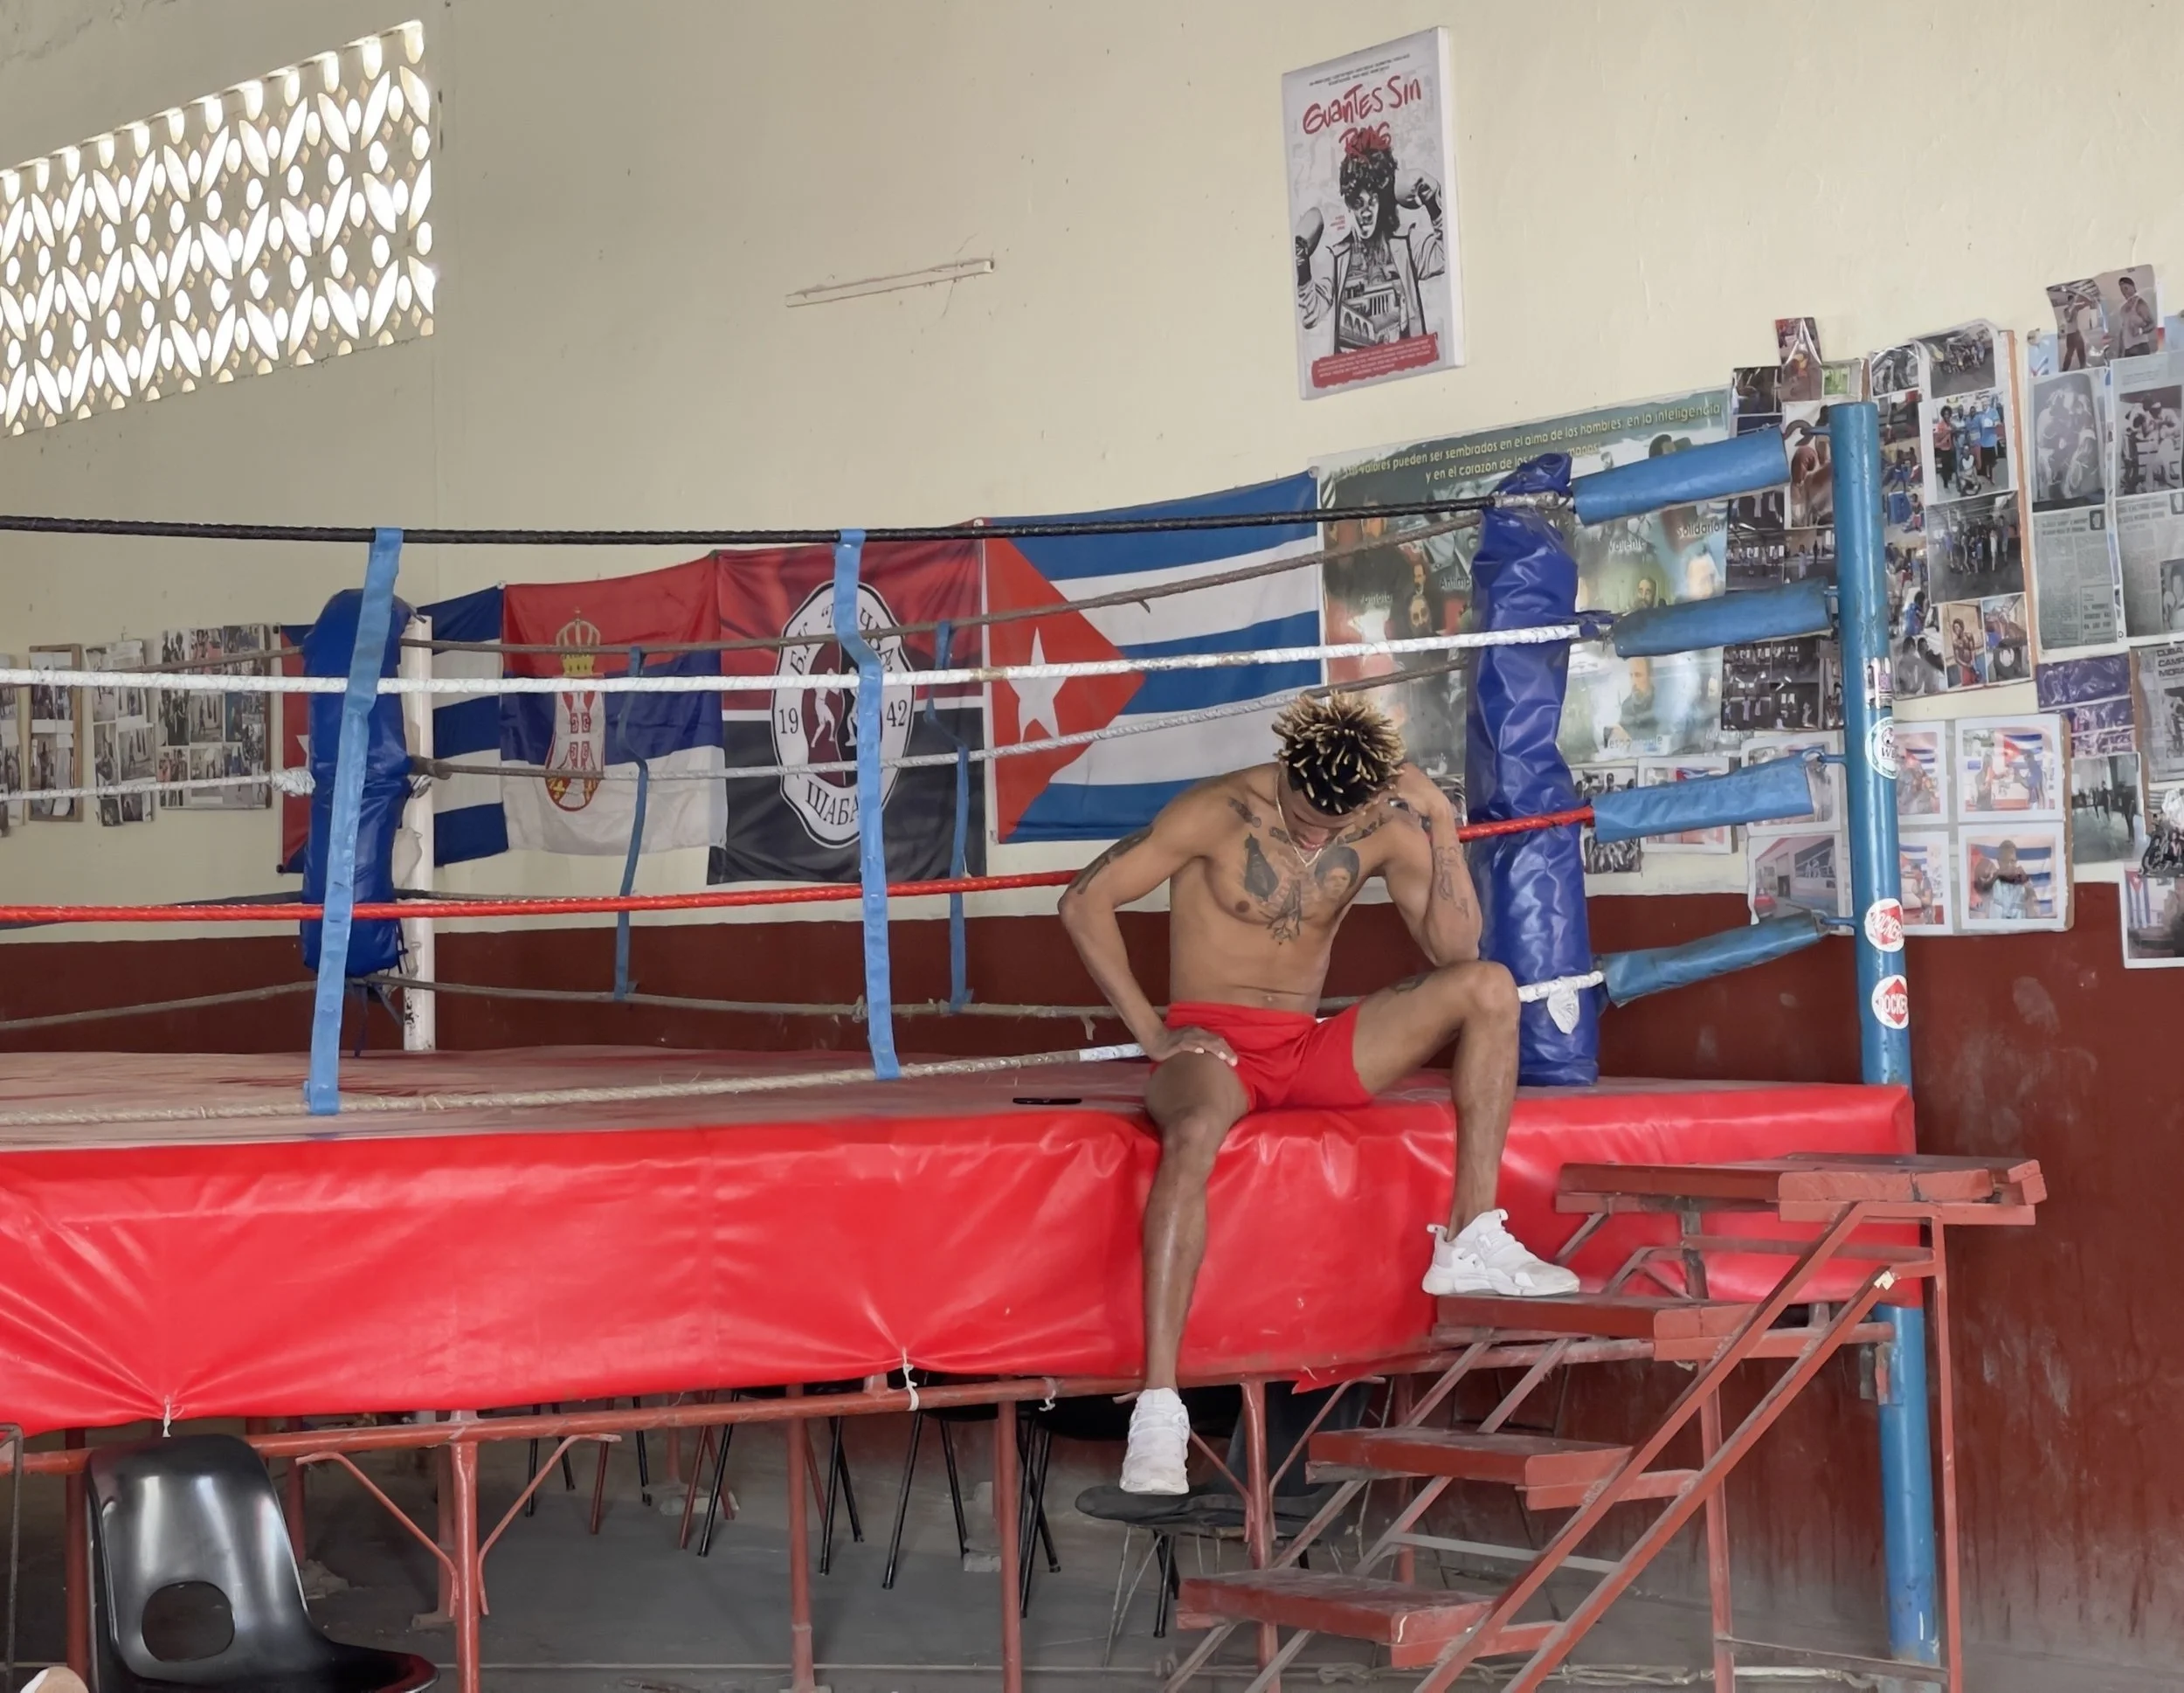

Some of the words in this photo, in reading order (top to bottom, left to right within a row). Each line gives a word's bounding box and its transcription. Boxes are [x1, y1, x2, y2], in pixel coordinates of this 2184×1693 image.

[1393, 453, 1427, 471] pueden
[1430, 451, 1443, 462] ser
[1446, 441, 1497, 460] sembrados
[1500, 439, 1512, 450] en
[1514, 436, 1523, 447] el
[1524, 433, 1549, 446] alma
[1551, 429, 1563, 440] de
[1565, 426, 1578, 438] los
[1628, 415, 1640, 427] en
[1655, 404, 1720, 422] inteligencia
[1425, 472, 1431, 484] y
[1434, 469, 1446, 480] en
[1448, 466, 1457, 477] el
[1499, 458, 1512, 469] de
[779, 708, 798, 734] 19
[886, 700, 908, 728] 42
